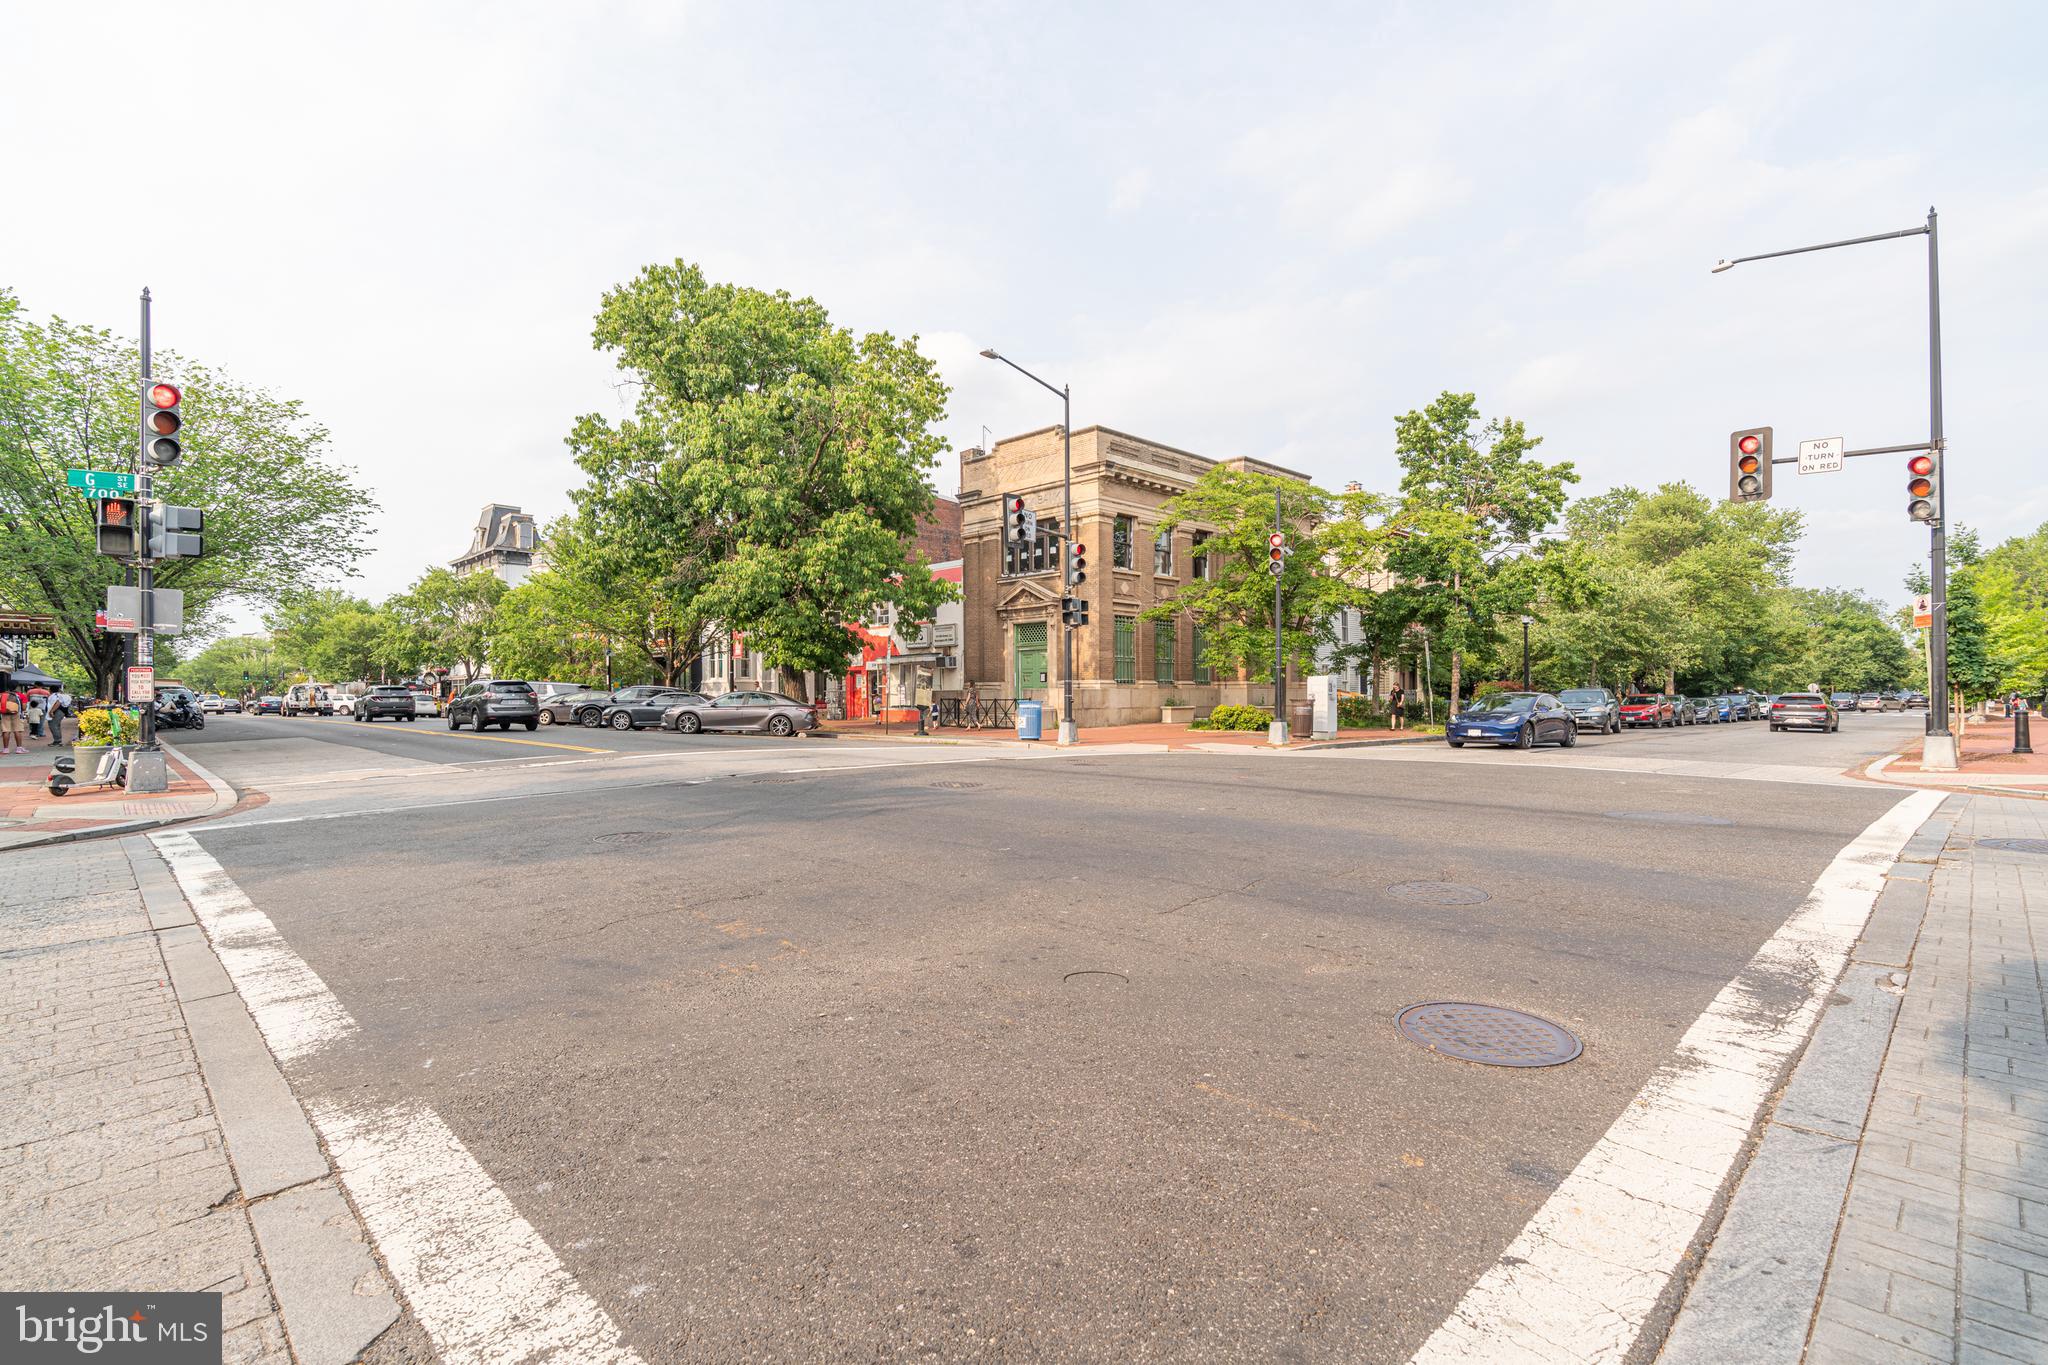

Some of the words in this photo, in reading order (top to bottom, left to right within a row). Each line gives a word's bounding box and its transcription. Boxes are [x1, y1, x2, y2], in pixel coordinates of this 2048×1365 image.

[1813, 442, 1829, 450] NO
[1808, 452, 1834, 460] TURN
[85, 473, 95, 486] G
[87, 487, 119, 499] 700
